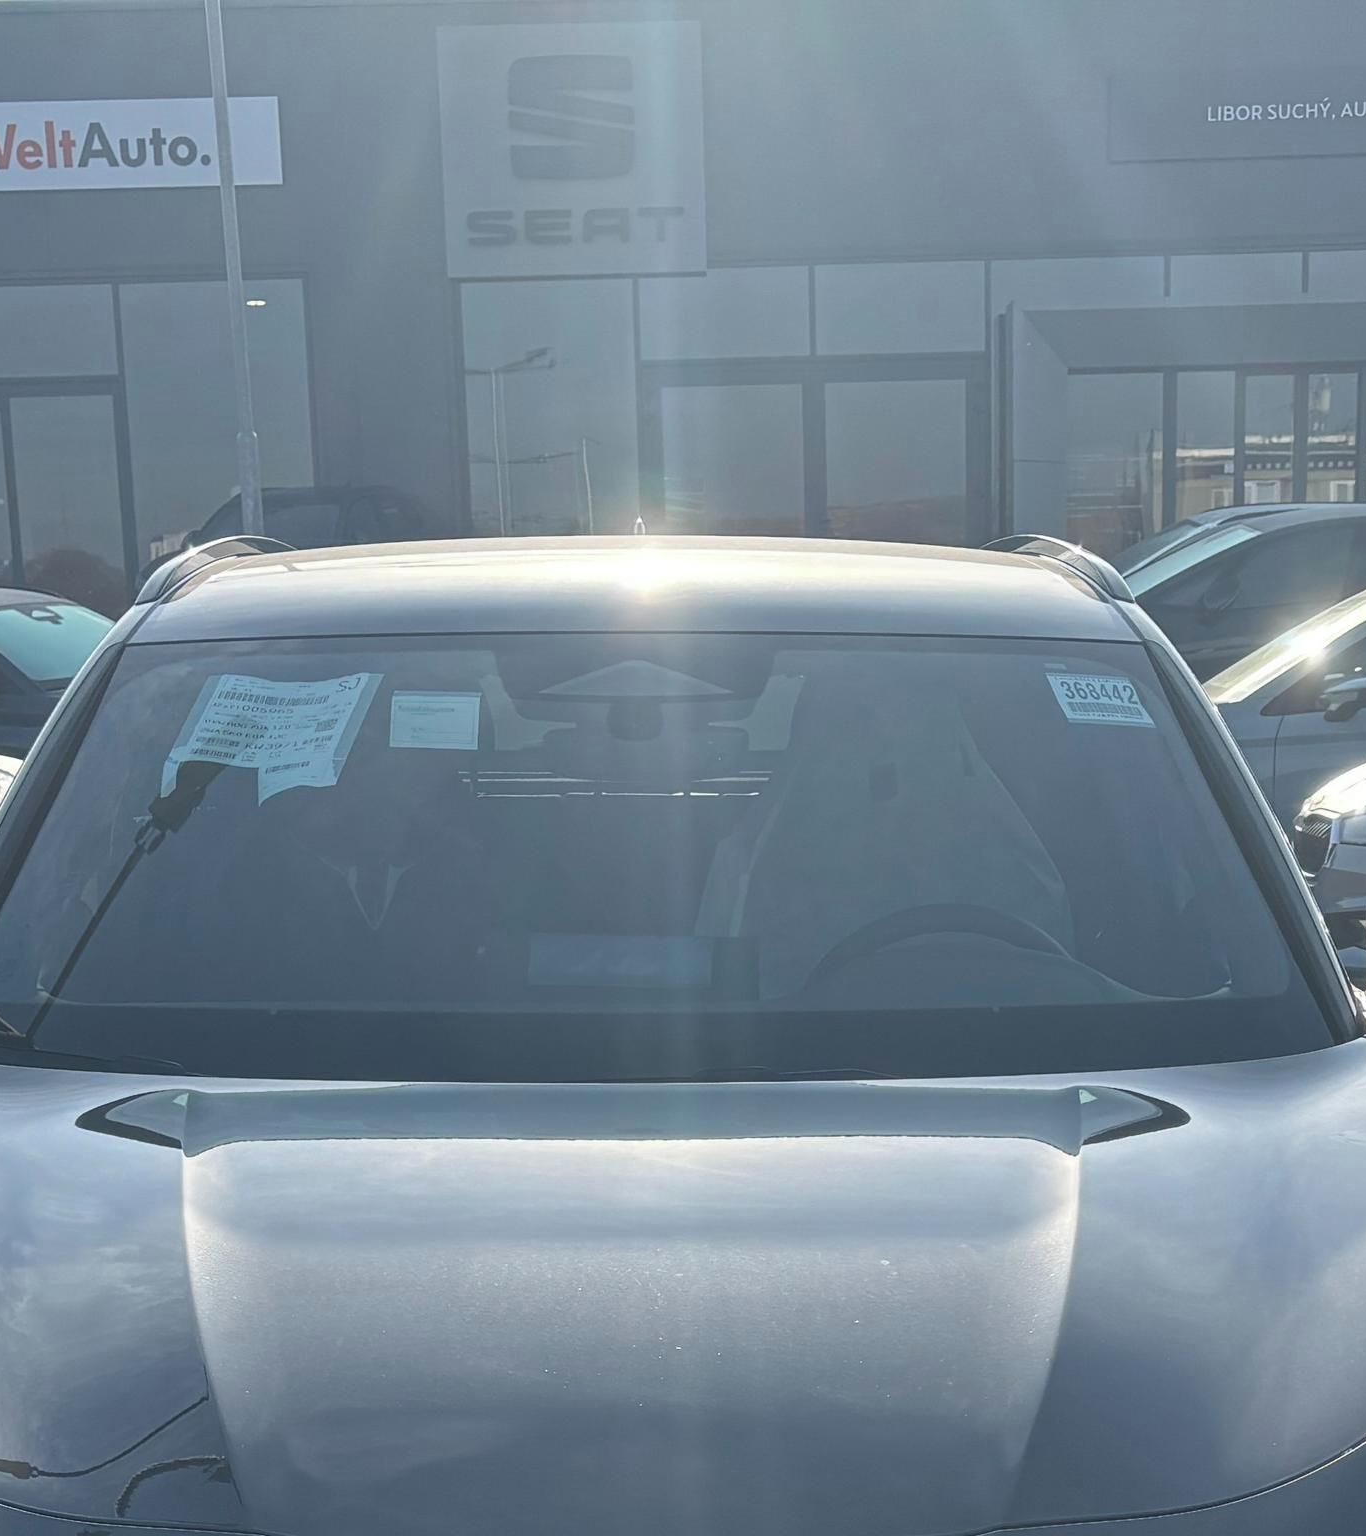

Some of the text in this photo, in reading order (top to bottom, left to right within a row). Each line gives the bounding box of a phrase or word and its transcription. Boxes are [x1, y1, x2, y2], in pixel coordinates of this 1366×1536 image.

[1207, 105, 1262, 122] LIBOR
[1267, 97, 1335, 121] SUCHÝ,
[466, 206, 685, 247] SEAT
[1060, 680, 1139, 705] 368442
